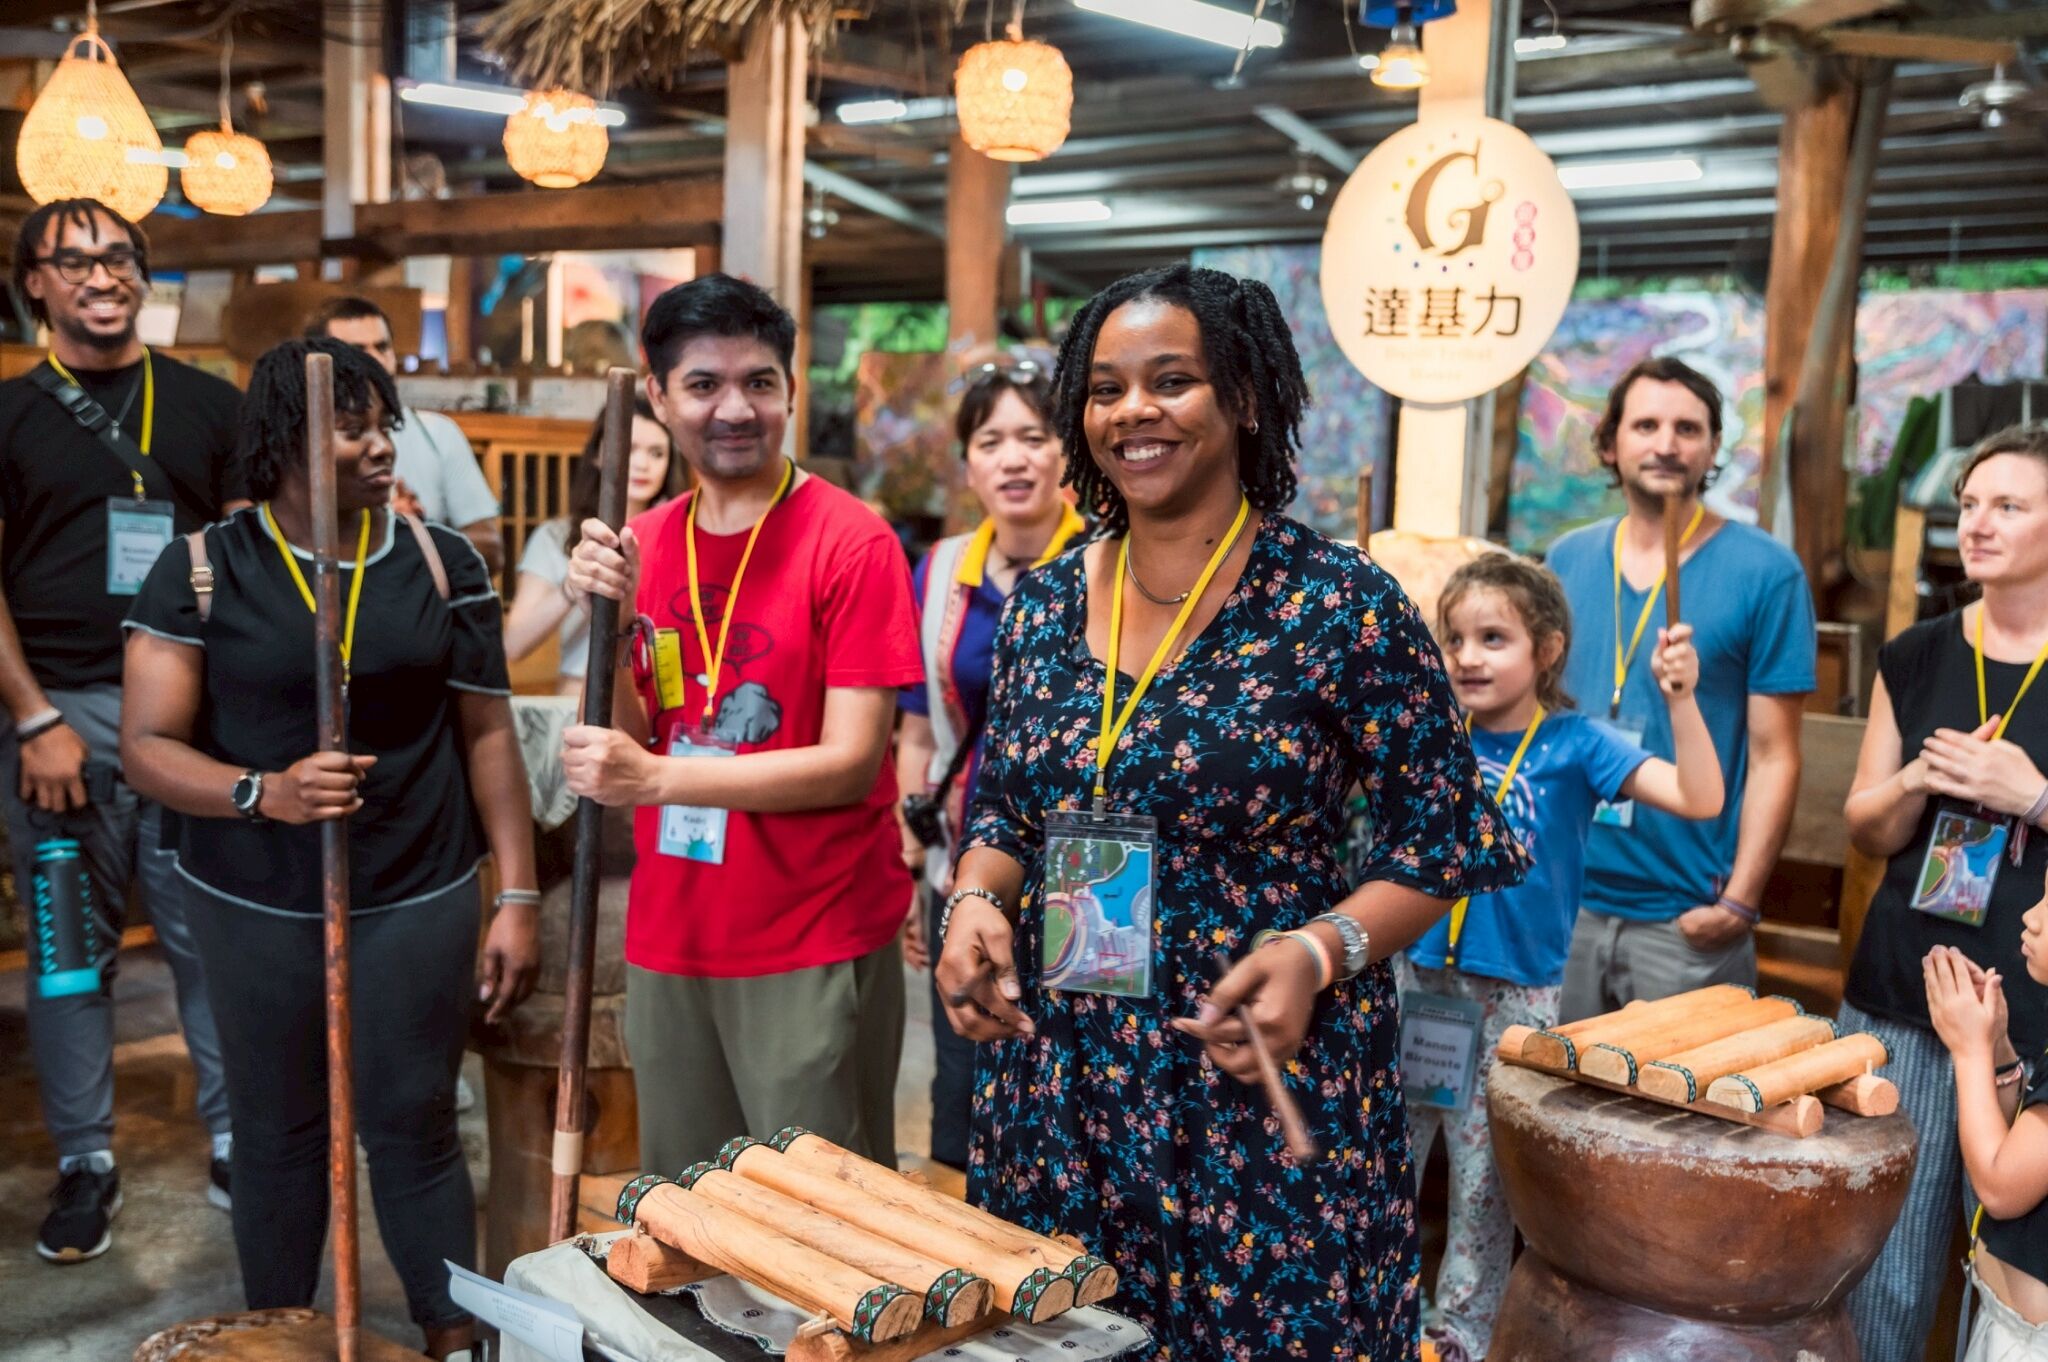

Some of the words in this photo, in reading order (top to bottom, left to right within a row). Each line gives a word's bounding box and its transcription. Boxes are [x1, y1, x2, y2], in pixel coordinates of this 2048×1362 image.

[1405, 138, 1504, 256] G
[1364, 285, 1522, 337] 達基力
[1413, 1036, 1456, 1052] Manon
